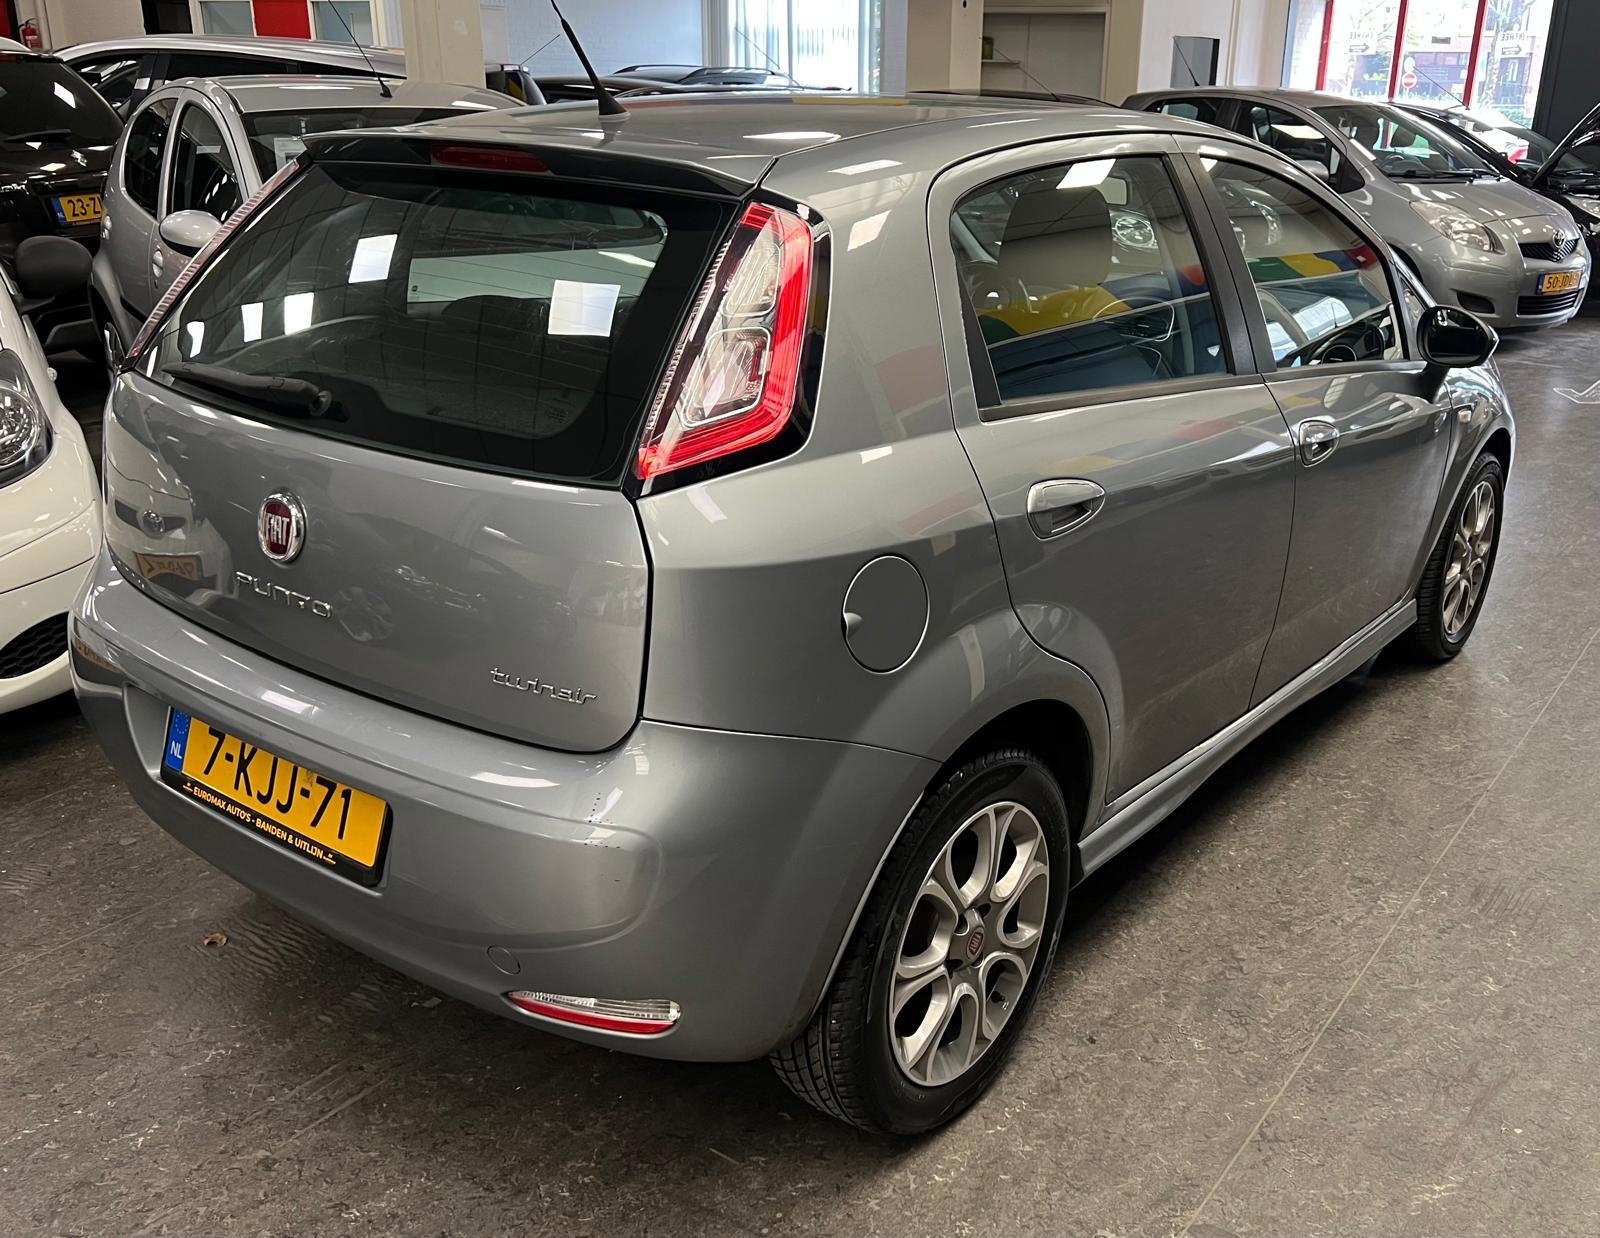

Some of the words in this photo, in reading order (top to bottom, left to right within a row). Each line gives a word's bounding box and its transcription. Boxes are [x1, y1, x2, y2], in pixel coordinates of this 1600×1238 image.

[265, 512, 290, 546] FIAT
[236, 571, 331, 617] PUNTO
[490, 667, 597, 704] twinair
[170, 740, 182, 759] NL
[203, 726, 352, 840] 7-KJJ-71
[193, 787, 227, 810] EUROMAX
[226, 803, 251, 823] AUTO'S
[255, 818, 288, 841] BANDEN
[287, 834, 294, 844] &
[294, 837, 324, 860] UITLIJN
